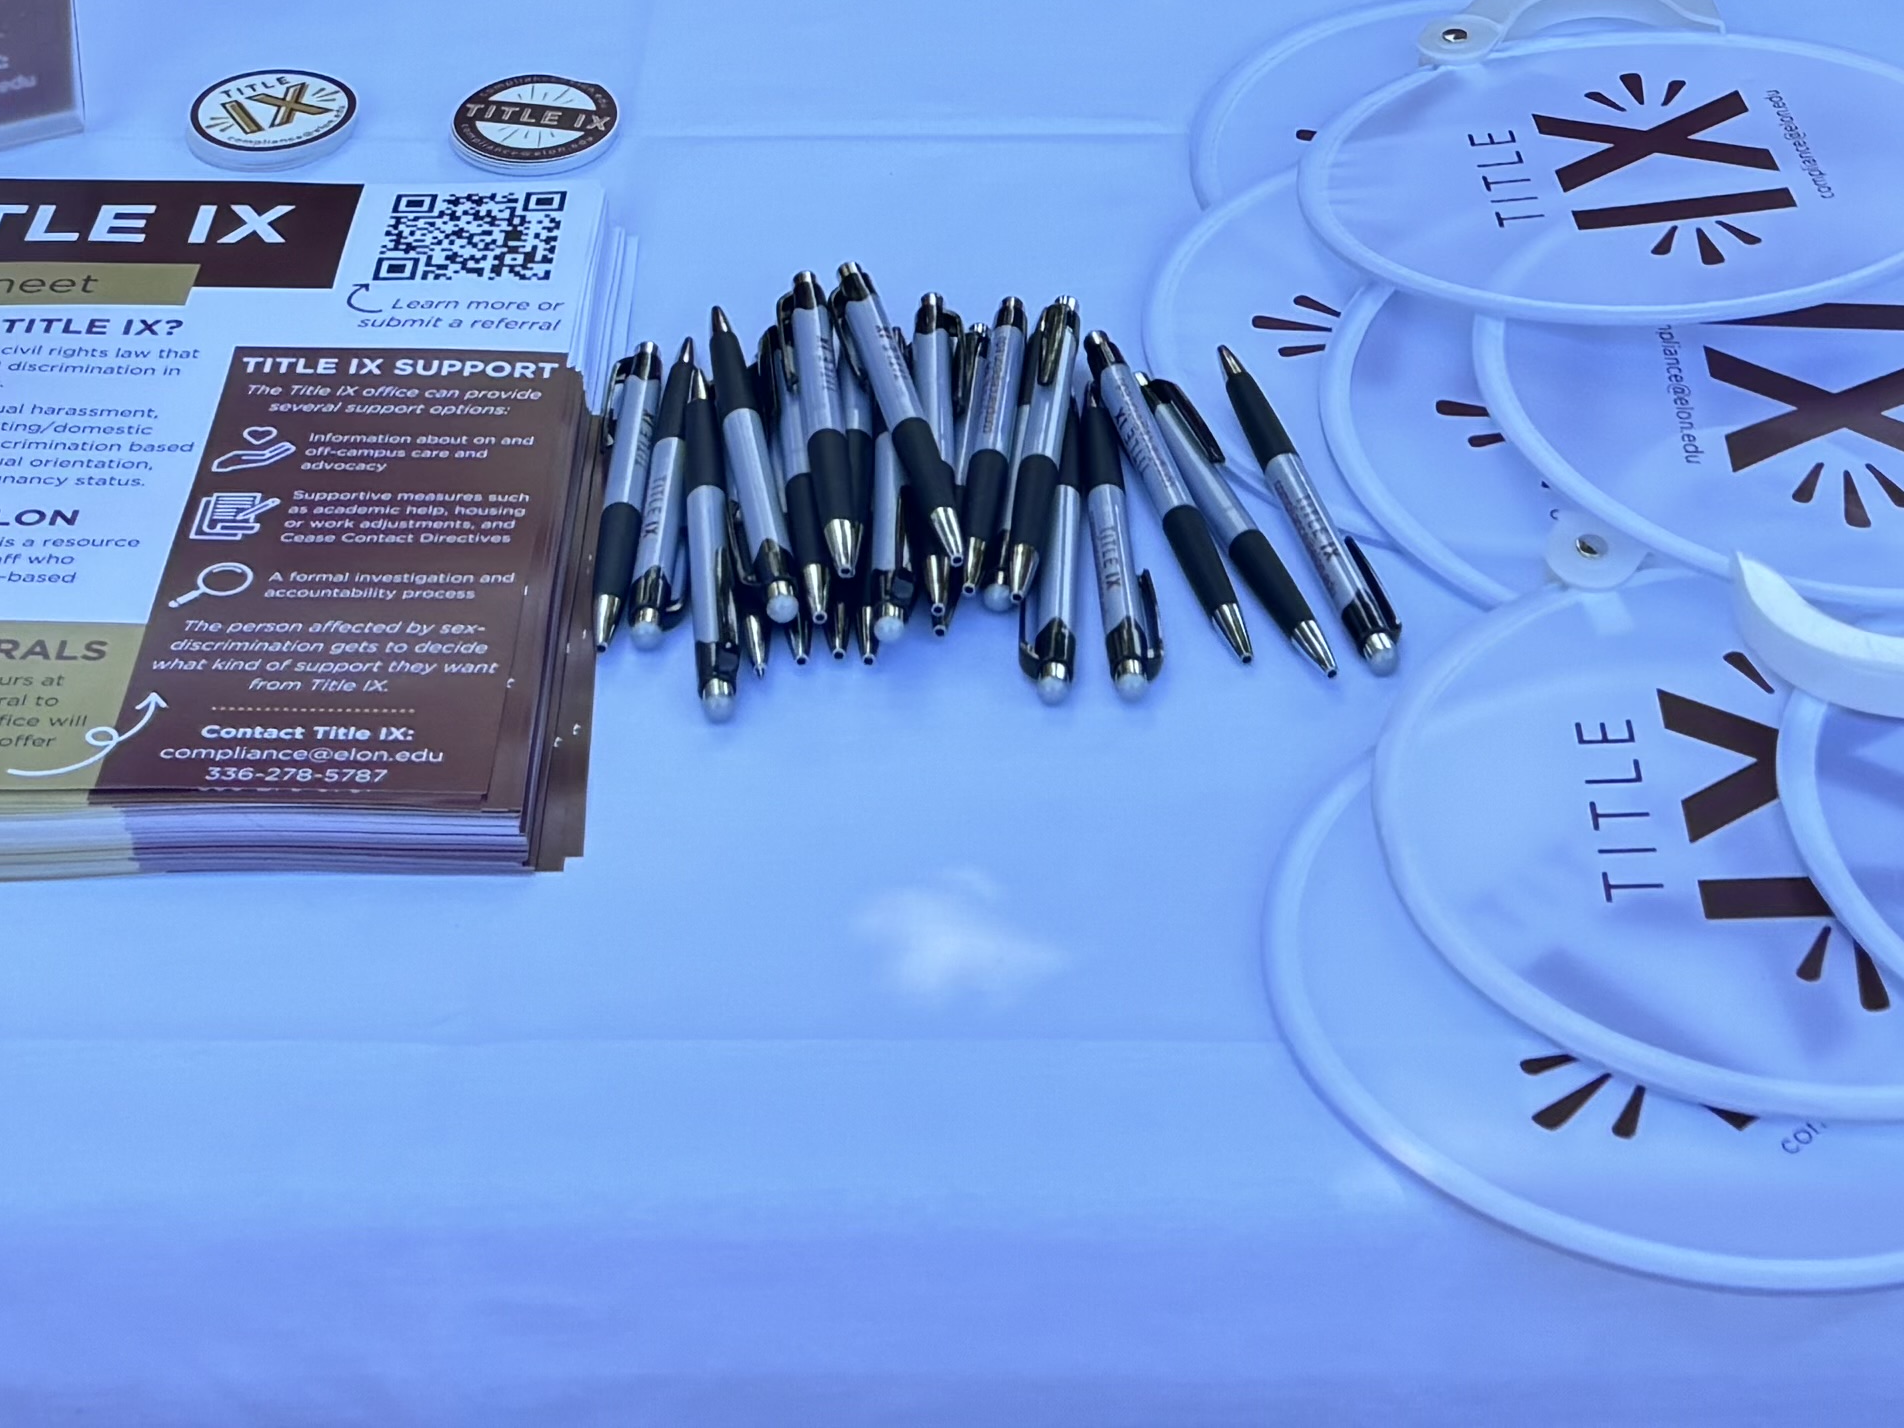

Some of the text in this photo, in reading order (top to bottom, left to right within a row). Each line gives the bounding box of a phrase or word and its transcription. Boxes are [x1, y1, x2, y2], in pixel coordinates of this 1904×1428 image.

[220, 76, 289, 98] TITLE
[221, 82, 334, 135] IX
[466, 103, 611, 131] TITLE IX
[1764, 89, 1835, 200] compliance@elon.edu
[1530, 89, 1797, 231] IX
[1468, 128, 1545, 228] TITLE
[186, 203, 296, 244] IX
[390, 297, 565, 311] Learn more or
[356, 315, 562, 331] submit a referral
[241, 356, 559, 379] TITLE IX SUPPORT
[39, 673, 65, 687] at
[34, 694, 60, 707] to
[48, 714, 88, 727] will
[199, 723, 415, 741] Contact Title IX:
[158, 745, 444, 763] compliance@elon.edu
[204, 765, 388, 783] 336-278-5787
[1576, 717, 1665, 902] TITLE
